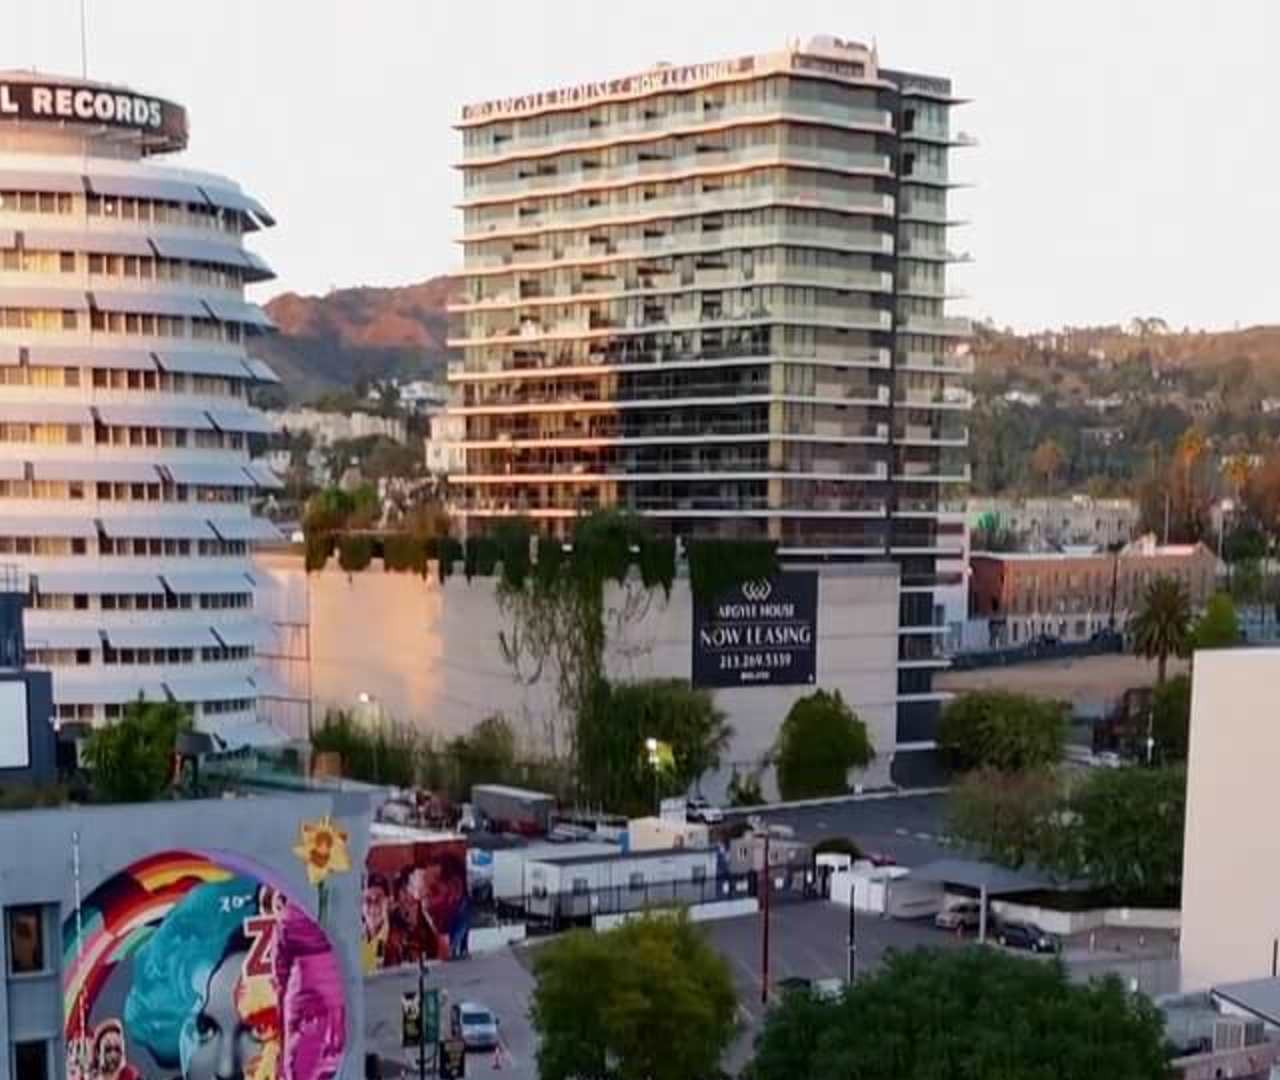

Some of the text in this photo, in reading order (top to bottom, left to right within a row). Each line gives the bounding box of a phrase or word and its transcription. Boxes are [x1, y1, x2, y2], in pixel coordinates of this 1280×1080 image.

[32, 87, 162, 127] RECORDS
[760, 603, 795, 617] HOUSE
[700, 625, 811, 646] NOW LEASING
